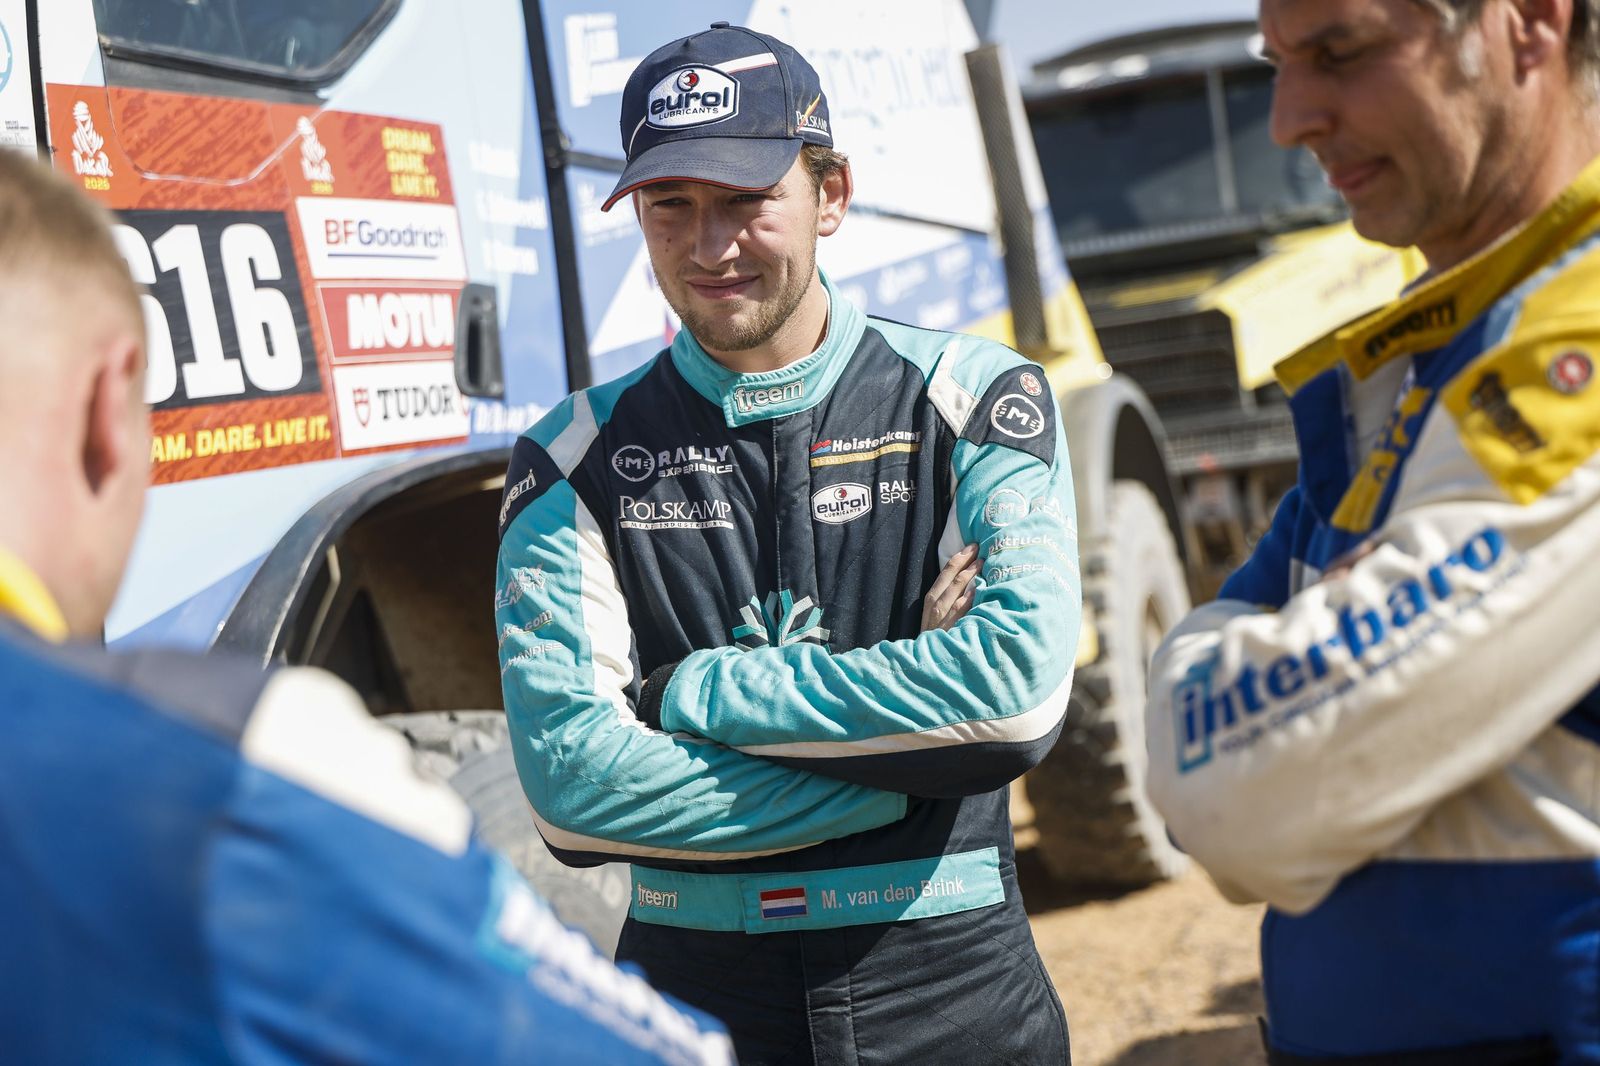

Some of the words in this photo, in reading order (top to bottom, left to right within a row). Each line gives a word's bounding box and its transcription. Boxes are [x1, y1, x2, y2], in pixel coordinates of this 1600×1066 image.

[651, 87, 730, 115] eurol
[658, 107, 719, 121] LUBRICANTS
[795, 110, 828, 132] POLSKAMP
[325, 219, 449, 249] BFGoodrich
[377, 385, 455, 420] TUDOR
[733, 378, 804, 413] freem
[152, 431, 193, 463] AM.
[196, 423, 262, 457] DARE.
[263, 416, 307, 449] LIVE
[308, 415, 332, 442] IT.
[657, 444, 730, 468] RALLY
[657, 463, 733, 478] EXPERIENCE
[618, 495, 732, 520] POLSKAMP
[816, 493, 866, 514] eurol
[824, 507, 862, 518] LUBRICANTS
[1181, 526, 1504, 747] interbaro
[637, 881, 679, 911] freem
[821, 889, 842, 909] M.
[847, 890, 878, 906] van
[884, 883, 916, 903] den
[921, 876, 966, 898] Brink
